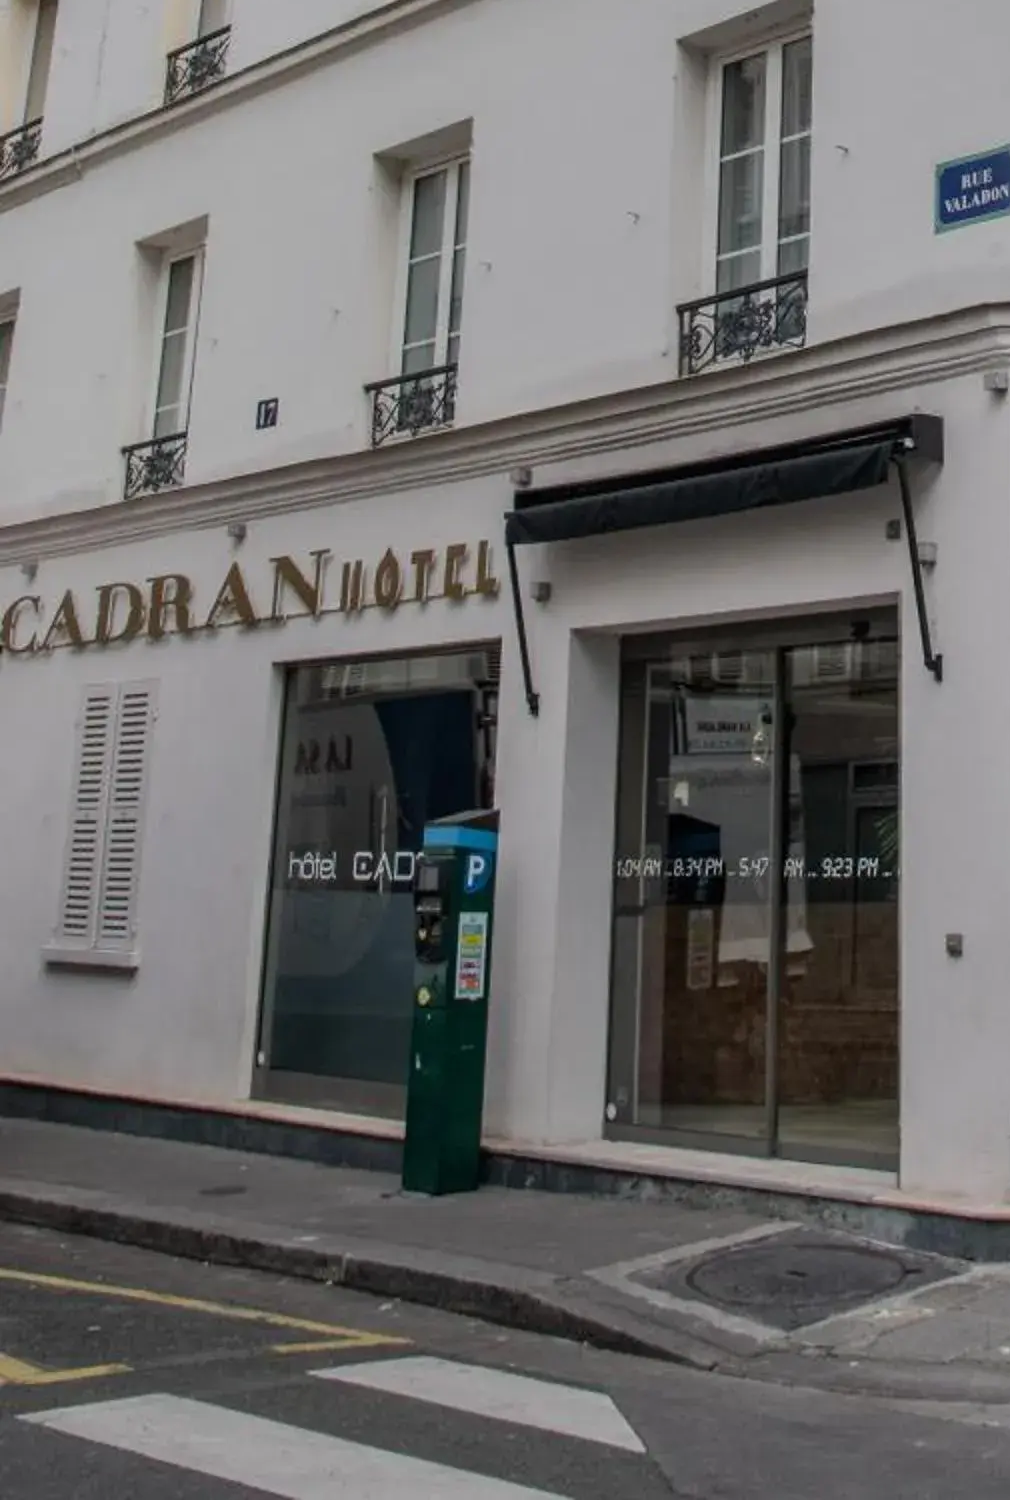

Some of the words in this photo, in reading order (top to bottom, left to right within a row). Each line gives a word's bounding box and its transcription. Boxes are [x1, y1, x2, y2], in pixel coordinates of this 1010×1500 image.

[961, 167, 992, 189] RUE
[945, 184, 1010, 213] VALADON
[1, 549, 331, 652] CADRAN
[289, 852, 337, 880] hôtel
[353, 852, 425, 881] CAD
[468, 855, 485, 887] P
[643, 858, 661, 877] AM
[705, 858, 723, 877] PM
[783, 858, 804, 878] AM
[857, 857, 879, 878] PM
